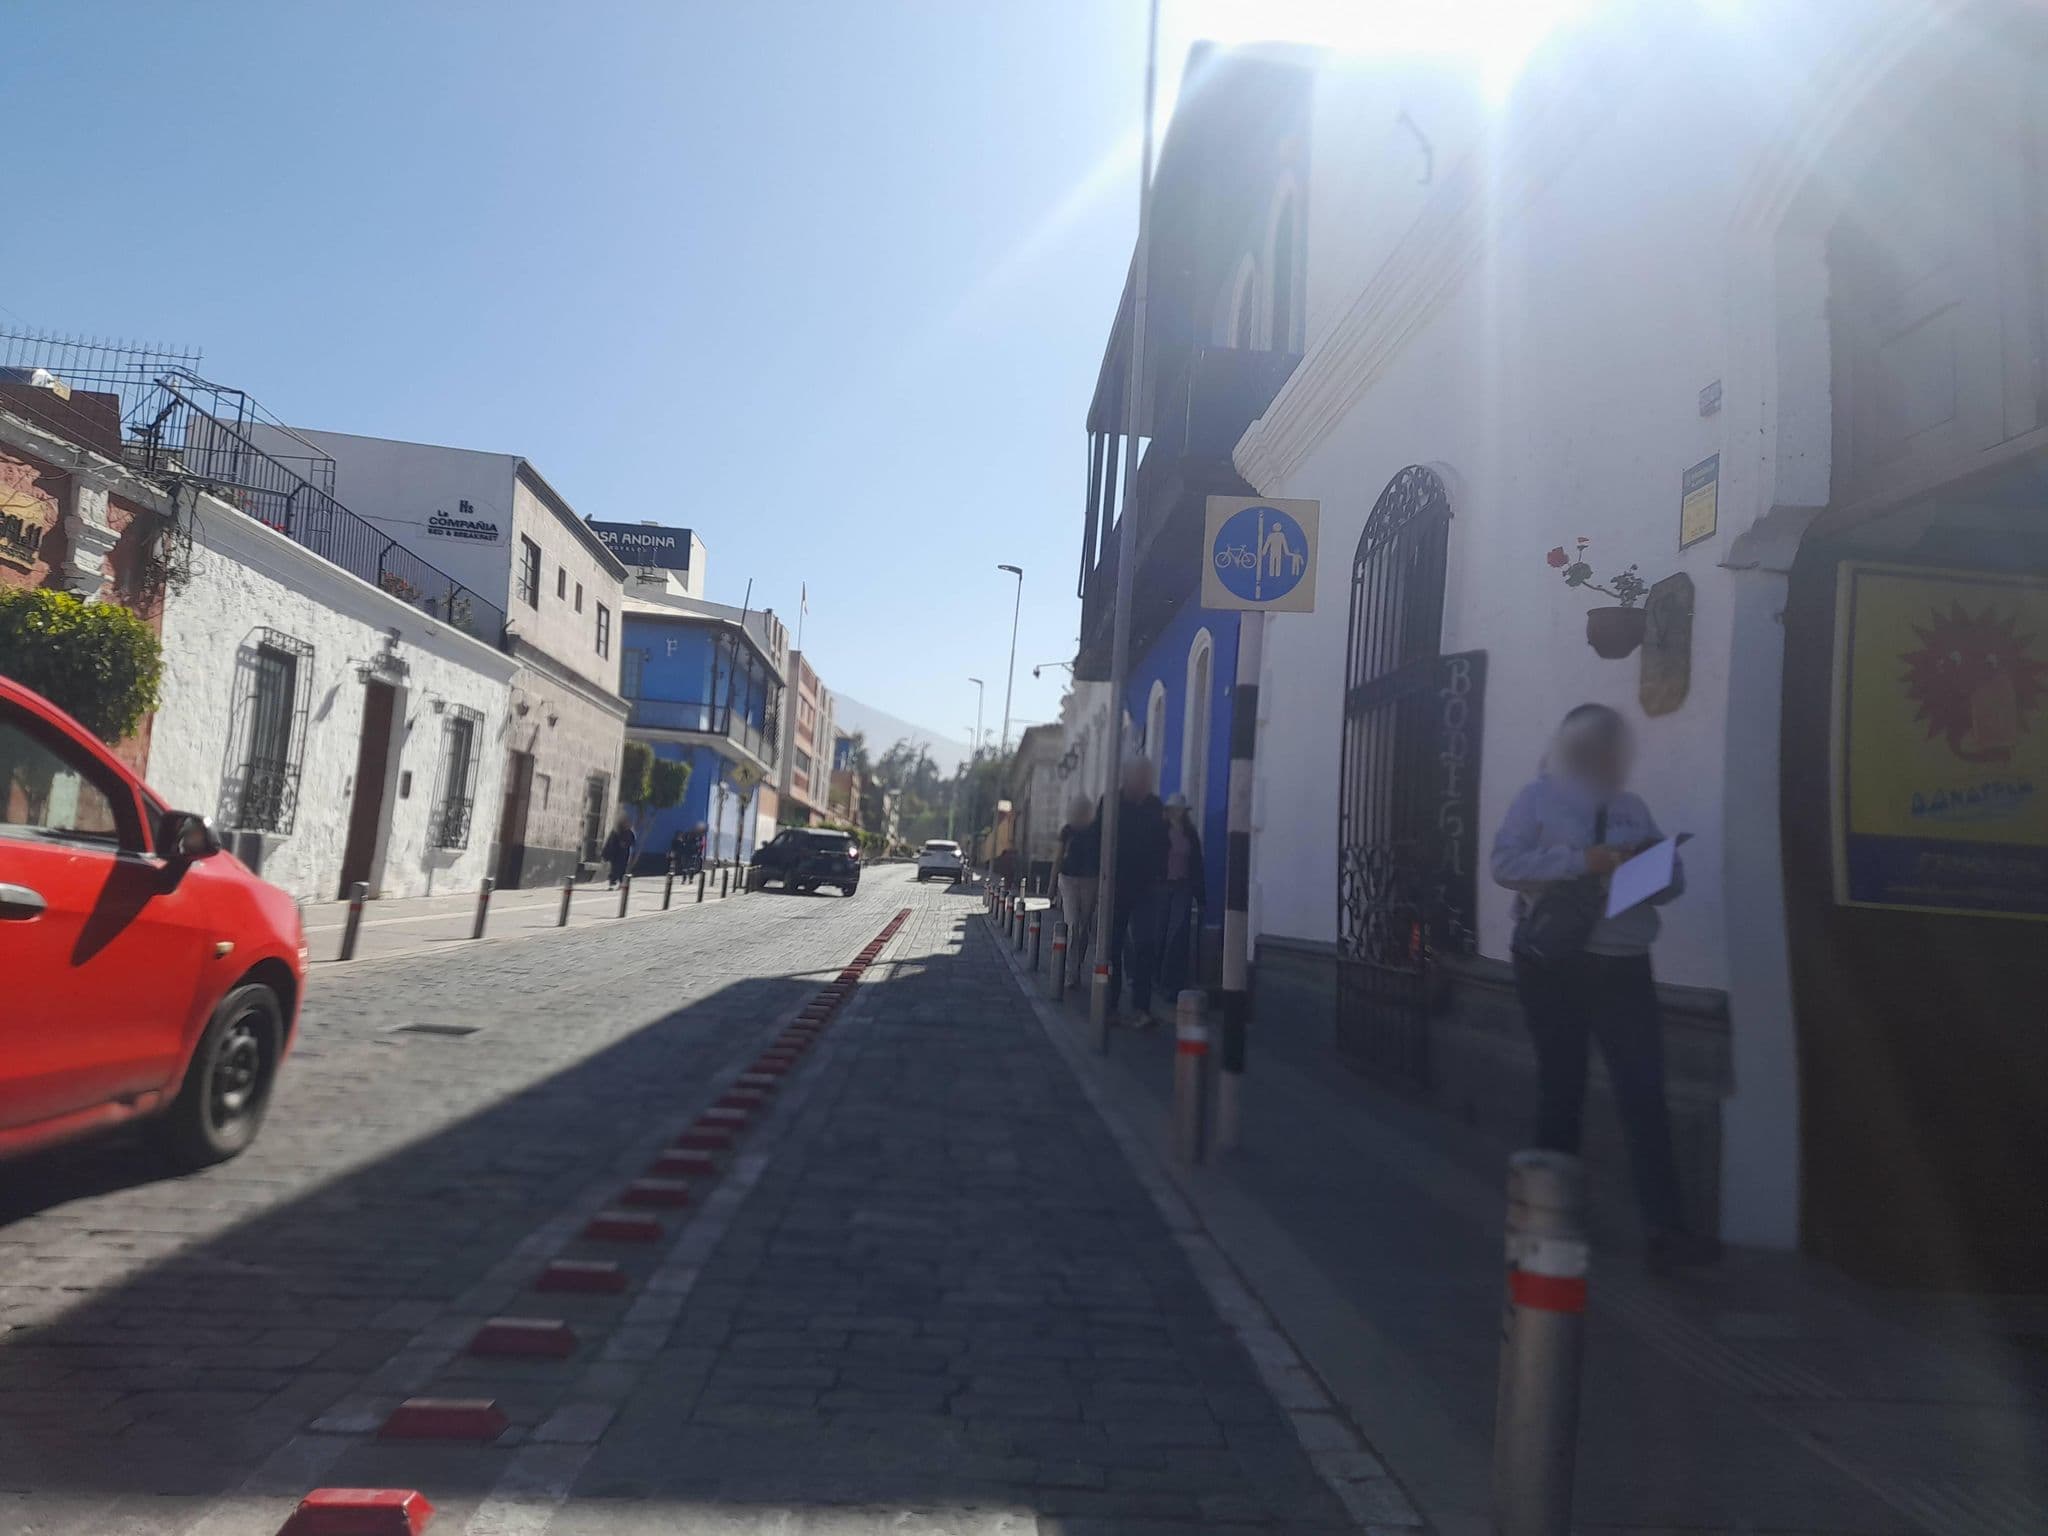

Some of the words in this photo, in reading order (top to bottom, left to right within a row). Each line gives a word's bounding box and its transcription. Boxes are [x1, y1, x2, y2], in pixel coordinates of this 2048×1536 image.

[428, 516, 498, 532] COMPAÑIA
[428, 528, 444, 536] BED
[453, 532, 498, 541] BREAKFAST
[622, 533, 675, 548] ANDINA
